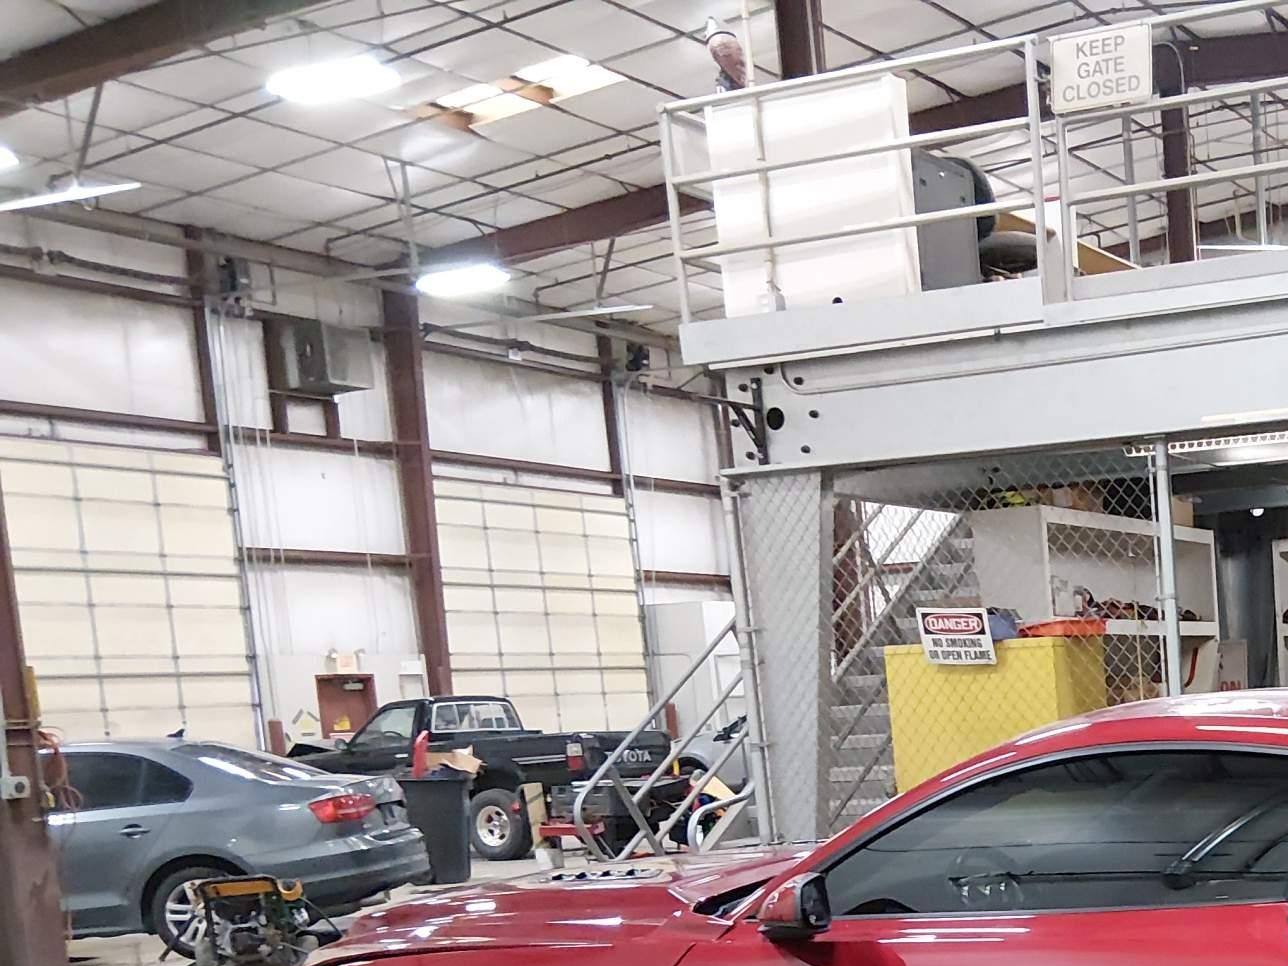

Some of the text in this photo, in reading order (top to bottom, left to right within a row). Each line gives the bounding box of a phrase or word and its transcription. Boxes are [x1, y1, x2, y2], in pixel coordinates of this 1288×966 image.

[1076, 35, 1125, 59] KEEP
[1077, 56, 1125, 79] GATE
[1062, 75, 1140, 102] CLOSED
[928, 617, 978, 630] DANGER
[931, 637, 983, 648] NO SMOKING
[928, 650, 993, 661] OR OPEN FLAME
[604, 748, 652, 763] TYOTA
